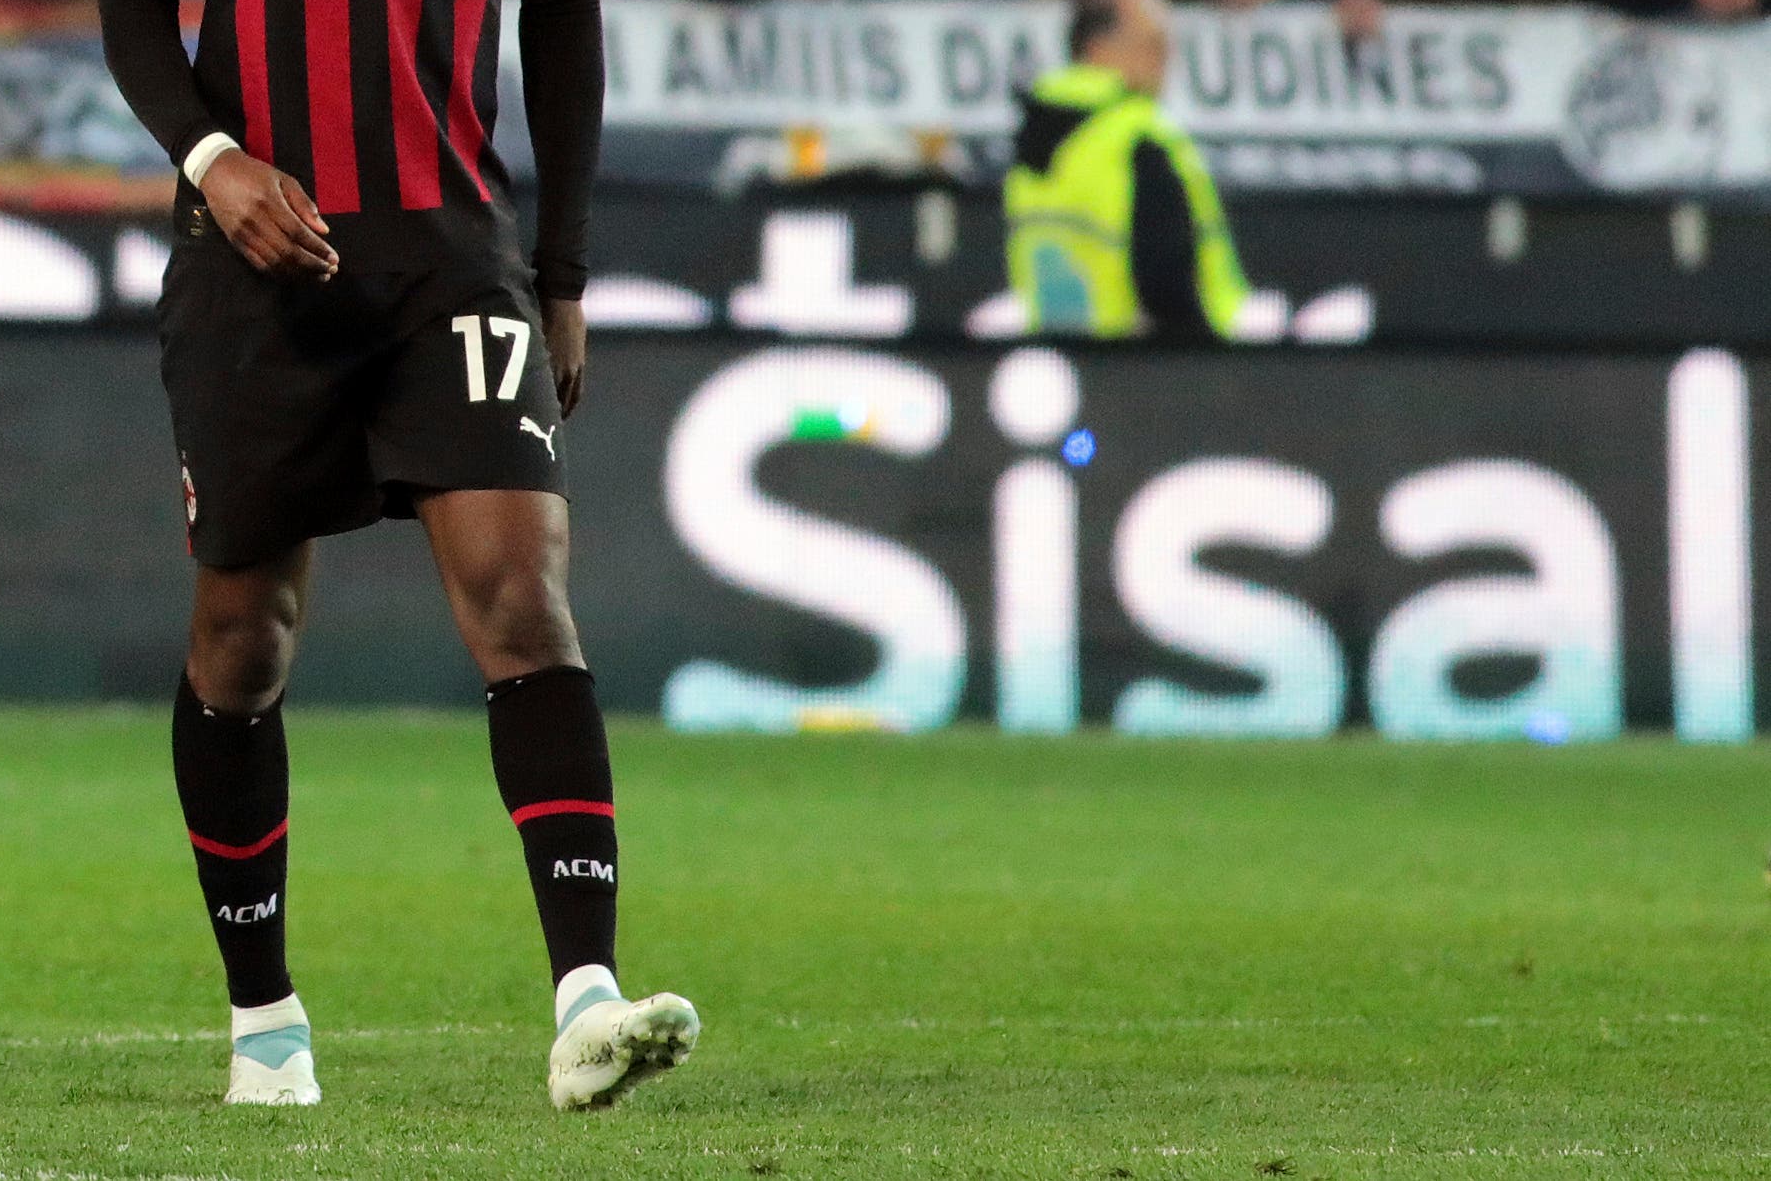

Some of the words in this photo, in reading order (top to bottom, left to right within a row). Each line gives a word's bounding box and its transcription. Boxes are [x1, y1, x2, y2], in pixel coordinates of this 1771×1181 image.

[451, 314, 531, 403] 17
[662, 344, 1754, 743] Sisal
[552, 858, 614, 883] ACM
[216, 892, 279, 924] ACM
